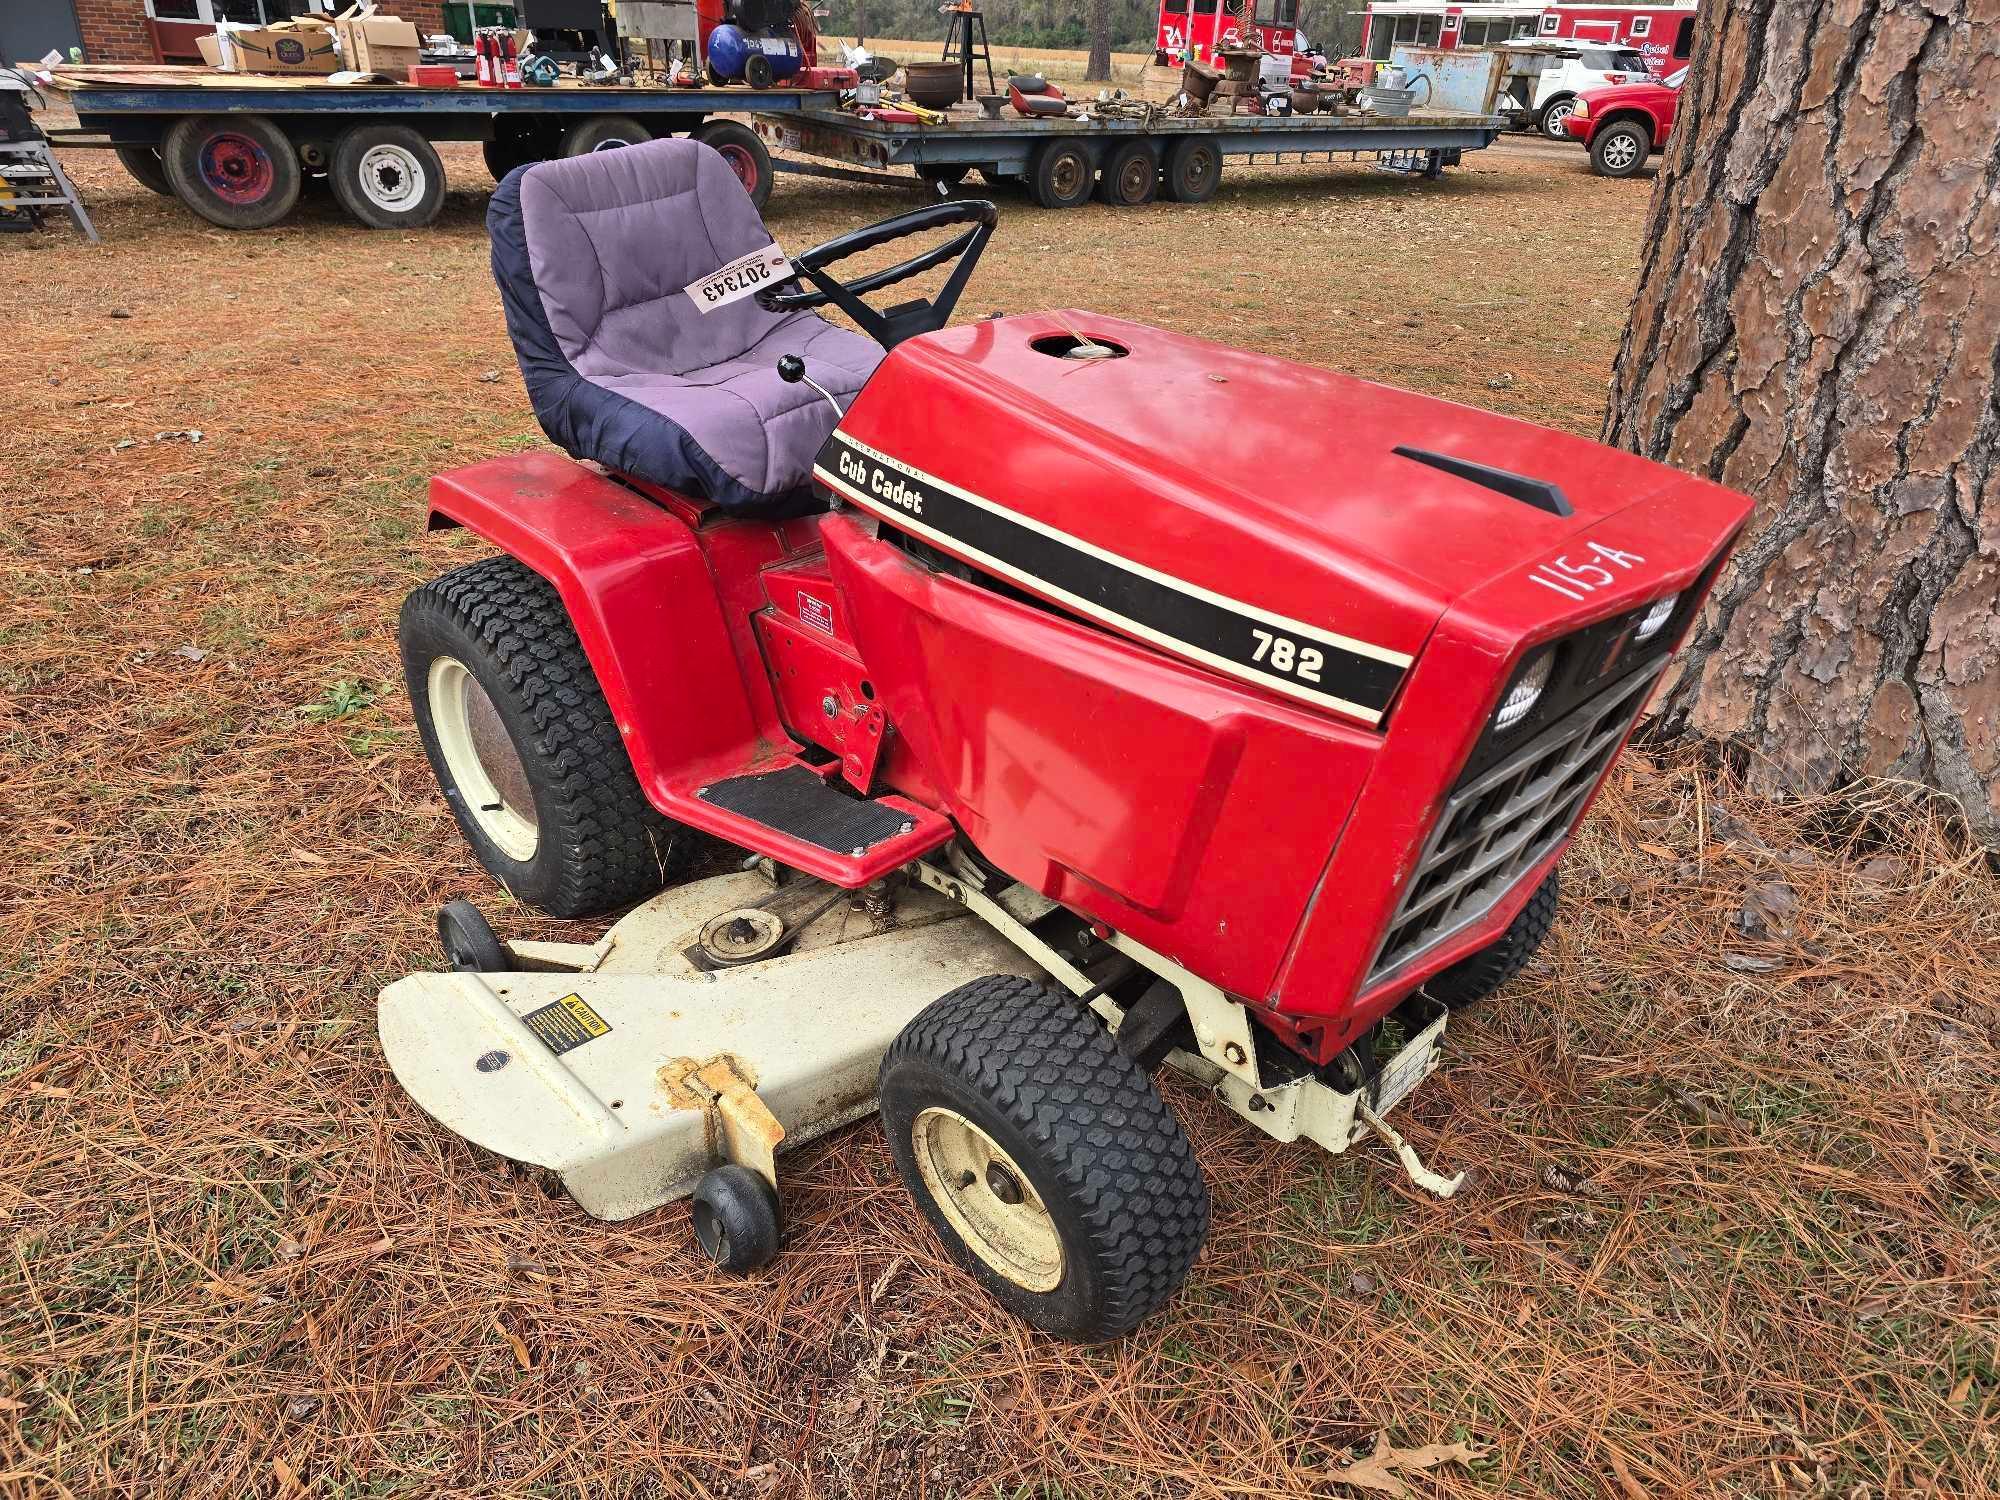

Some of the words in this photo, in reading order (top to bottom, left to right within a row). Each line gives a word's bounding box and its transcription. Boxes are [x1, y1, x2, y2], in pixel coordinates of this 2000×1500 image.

[702, 262, 771, 302] 207343
[839, 450, 867, 485] Cub
[871, 468, 922, 514] Cadet
[1528, 541, 1646, 601] 115-A
[1251, 628, 1324, 683] 782
[574, 1006, 604, 1032] CAUTION
